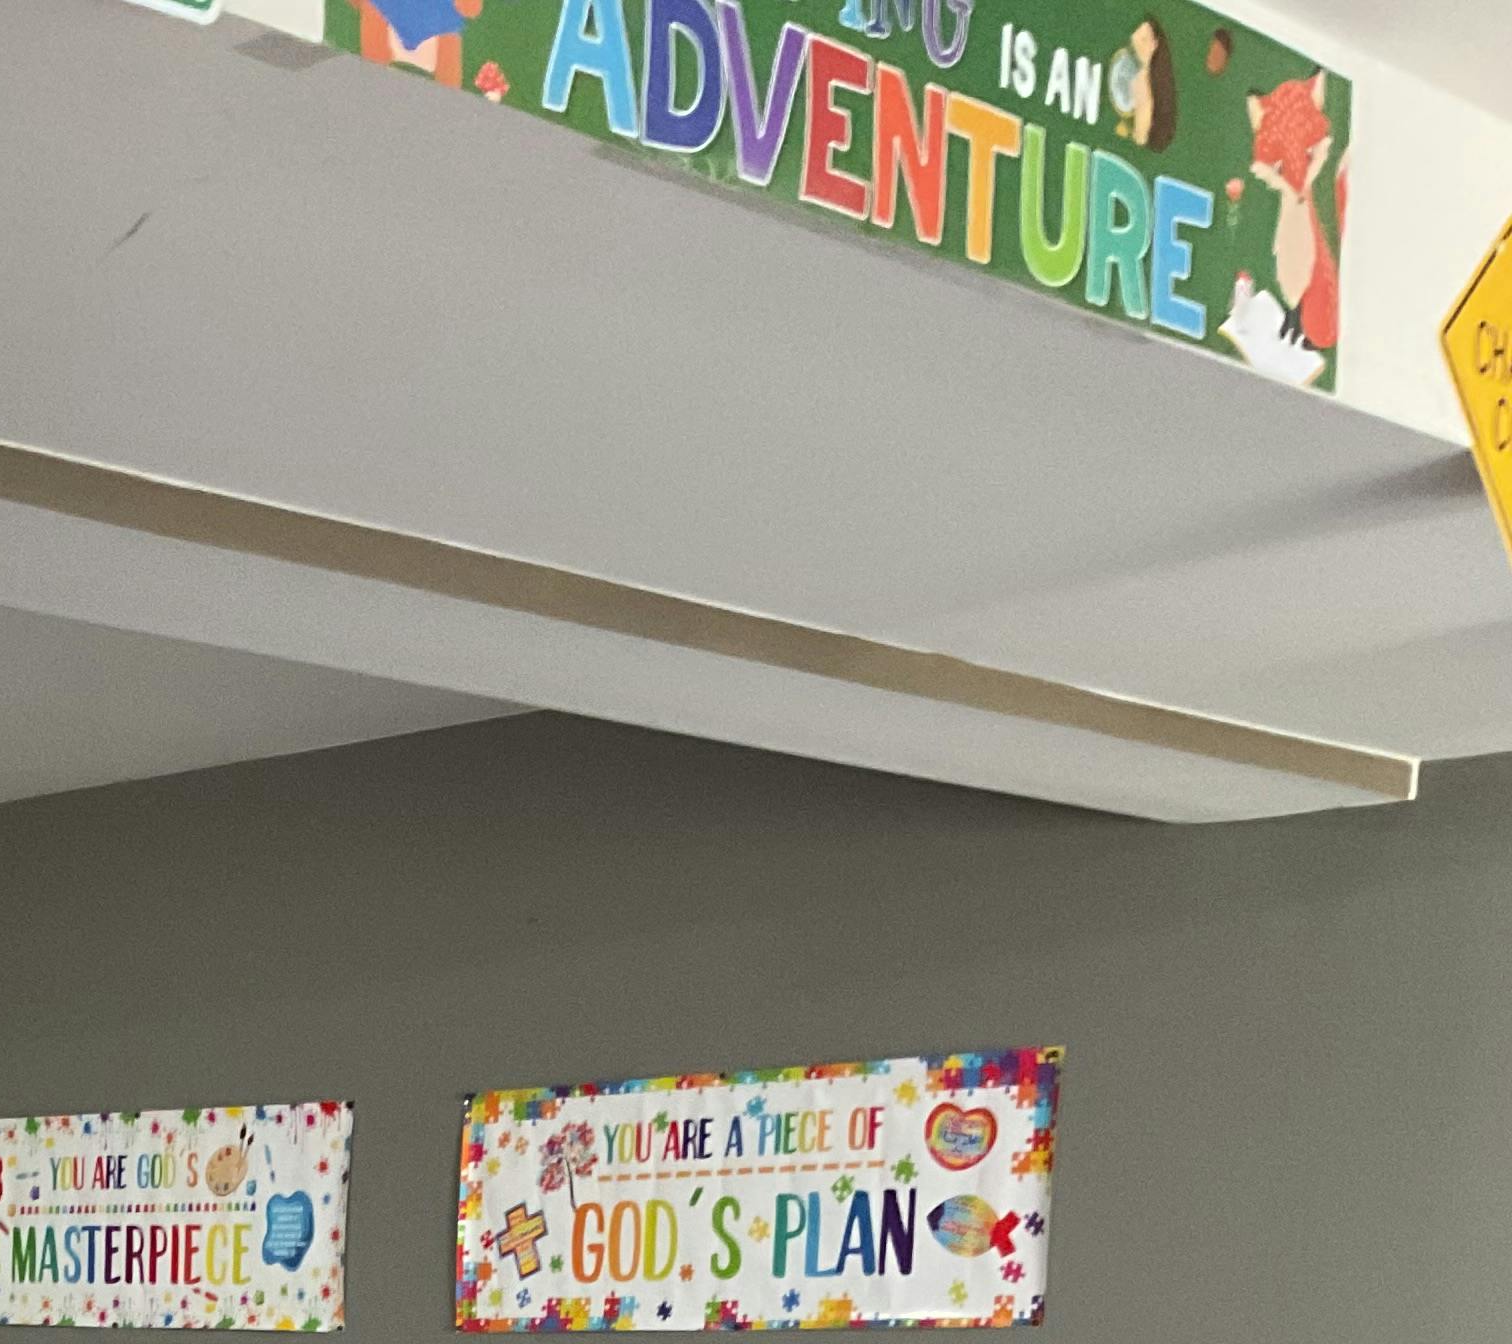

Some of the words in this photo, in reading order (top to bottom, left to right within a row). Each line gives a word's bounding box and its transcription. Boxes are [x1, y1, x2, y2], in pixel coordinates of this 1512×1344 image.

[999, 22, 1039, 98] IS
[1044, 47, 1102, 125] AN
[542, 0, 1214, 341] ADVENTURE
[49, 1155, 85, 1191] YOU
[92, 1154, 128, 1190] ARE
[603, 1122, 652, 1164] YOU
[662, 1118, 713, 1161] ARE
[724, 1115, 745, 1157] A
[756, 1107, 833, 1154] PIECE
[847, 1105, 886, 1150] OF
[10, 1223, 253, 1286] MASTERPIECE
[571, 1186, 742, 1285] GOD'S
[772, 1186, 918, 1279] PLAN
